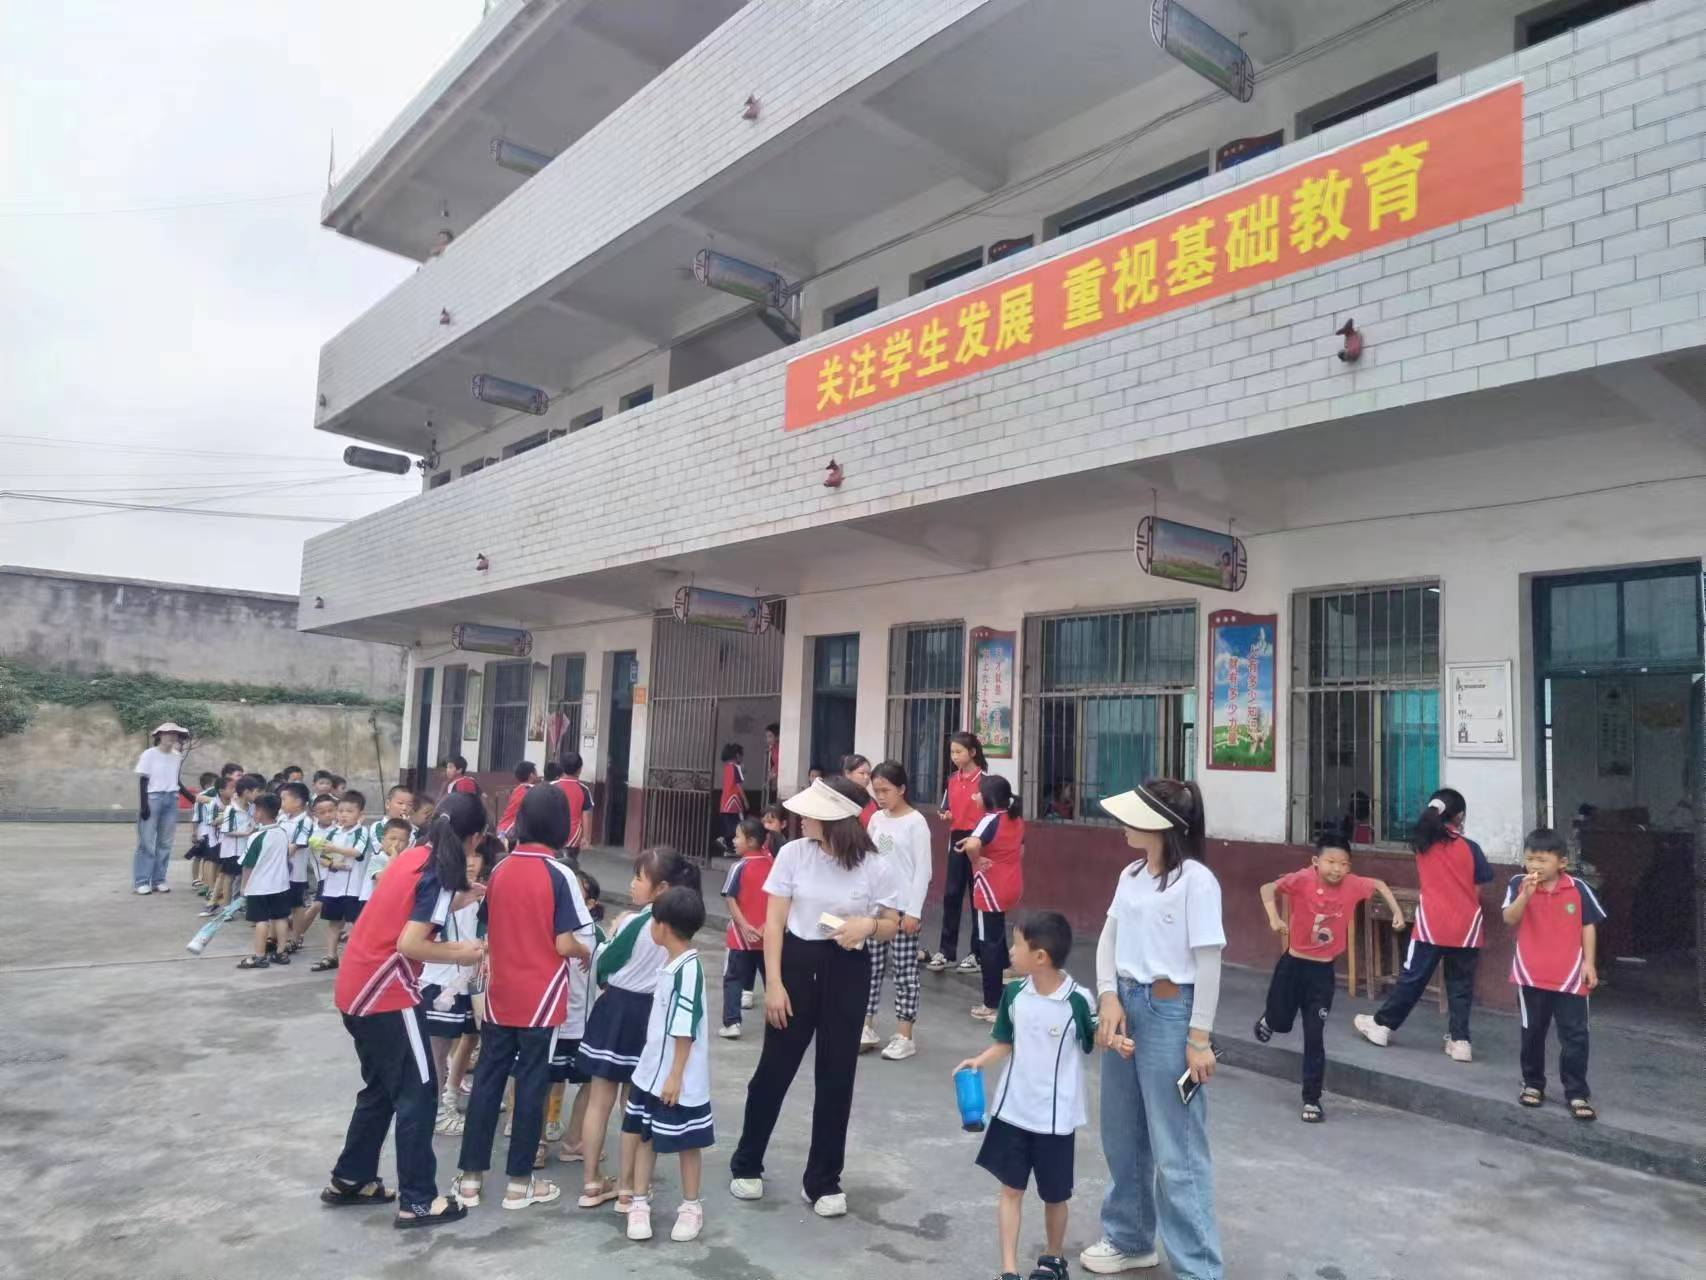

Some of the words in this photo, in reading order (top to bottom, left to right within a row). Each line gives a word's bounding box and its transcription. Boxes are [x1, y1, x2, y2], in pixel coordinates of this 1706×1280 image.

[816, 283, 1034, 411] 关注学生发展
[1062, 140, 1430, 330] 重视基础教育
